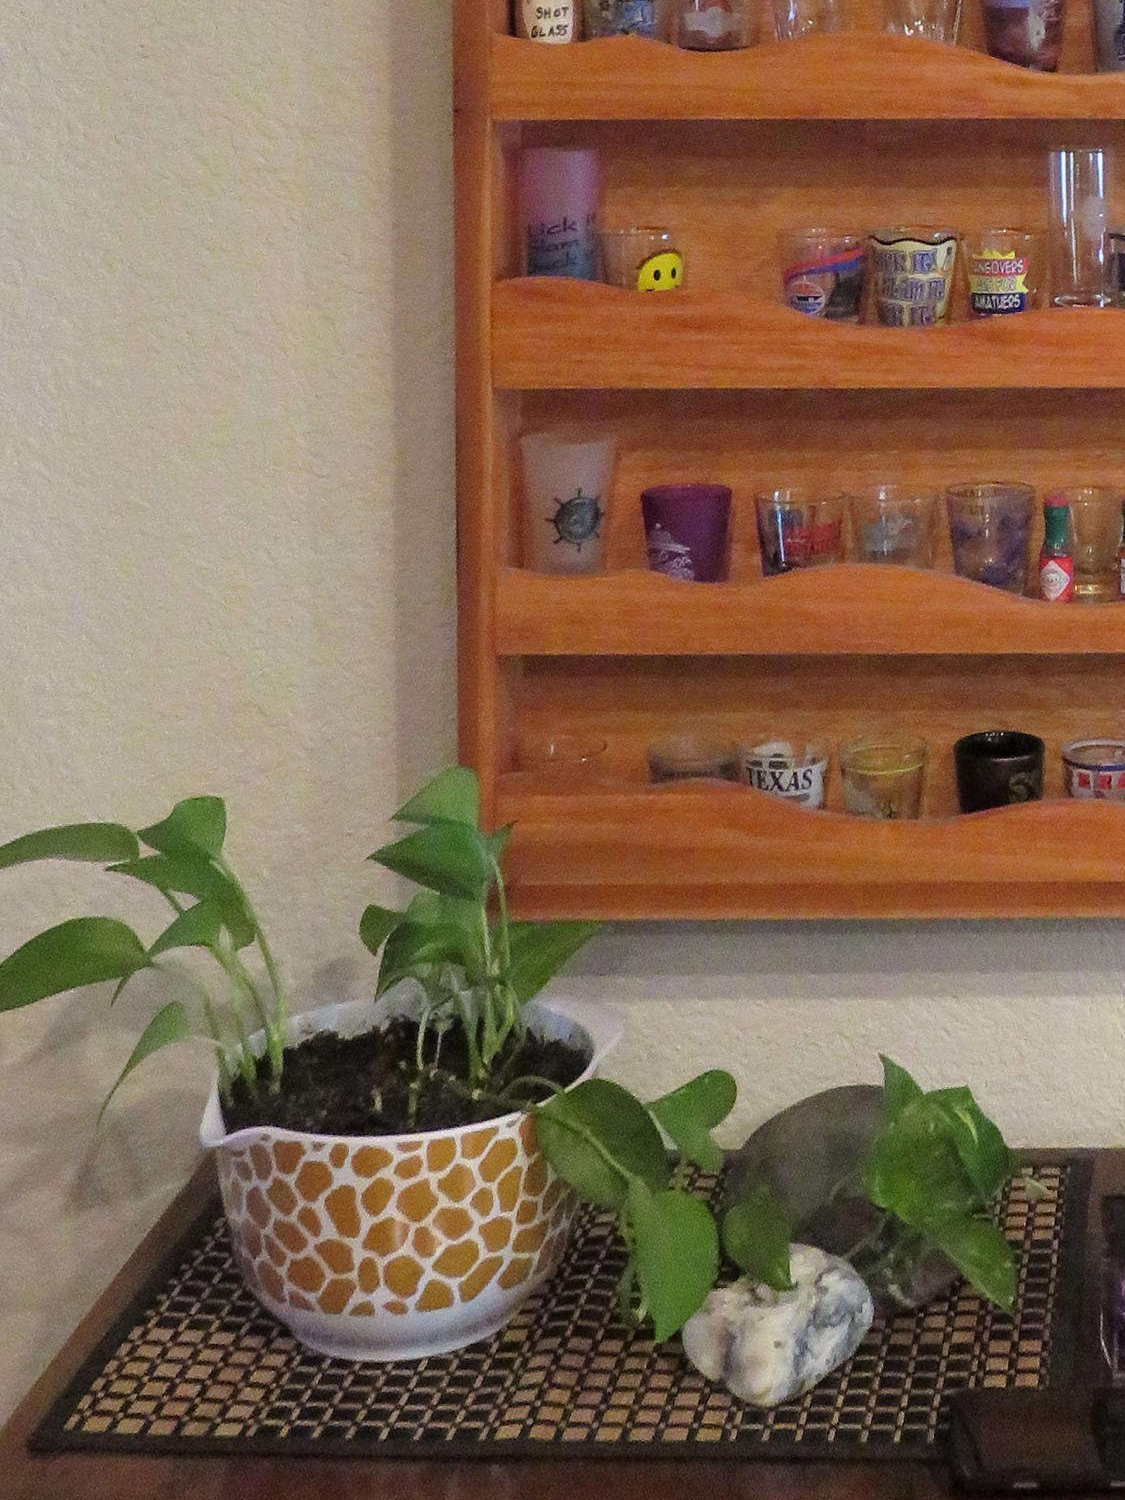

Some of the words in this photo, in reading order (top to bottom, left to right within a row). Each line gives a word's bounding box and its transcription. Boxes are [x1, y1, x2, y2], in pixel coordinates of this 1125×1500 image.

[536, 6, 569, 18] SHOT
[530, 25, 569, 39] GLASS
[745, 766, 813, 792] TEXAS
